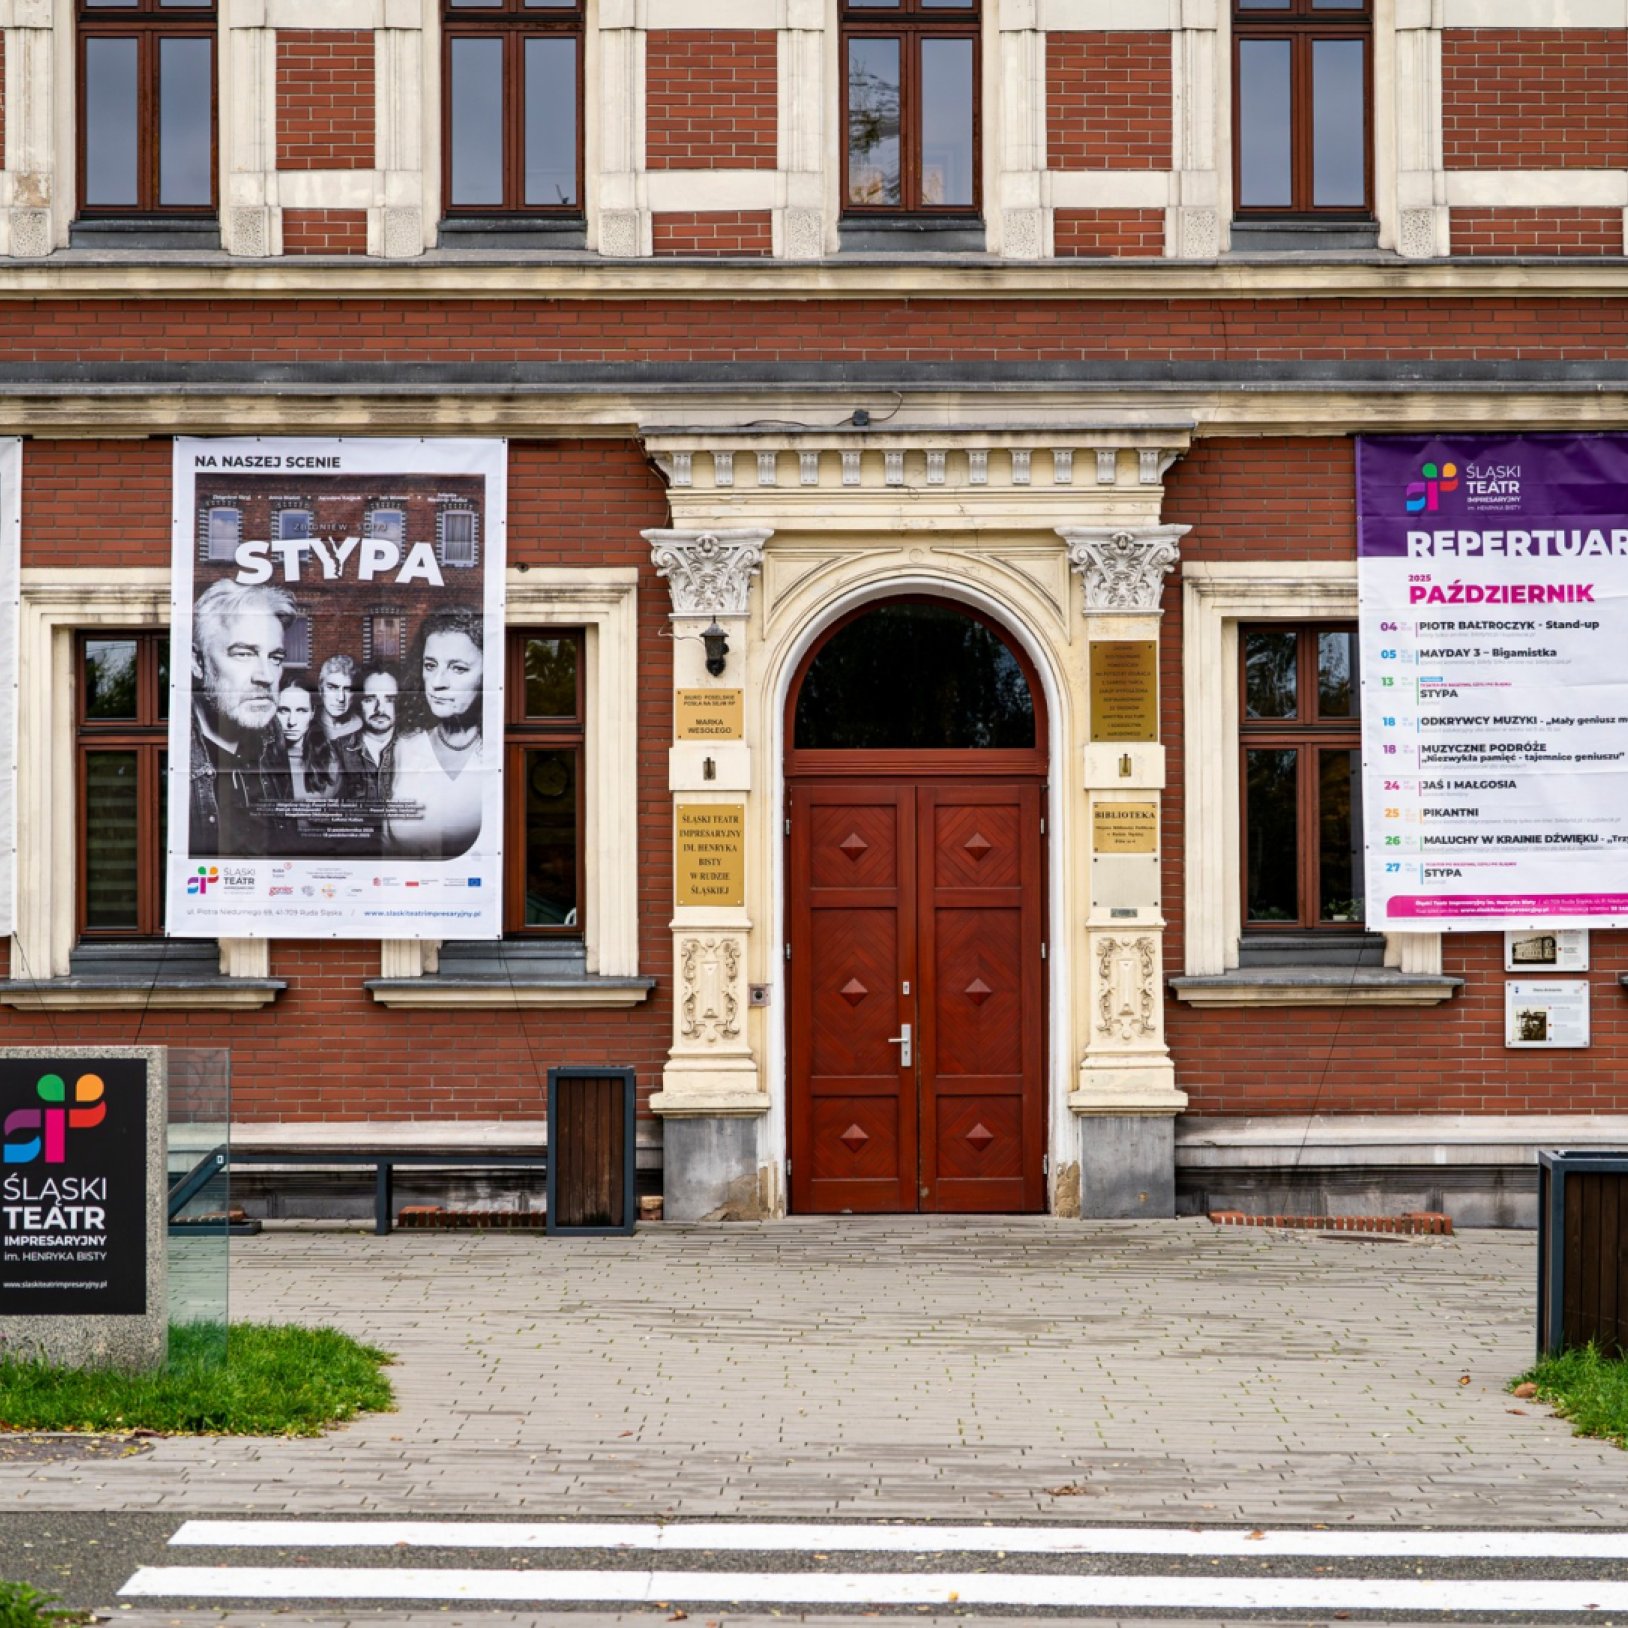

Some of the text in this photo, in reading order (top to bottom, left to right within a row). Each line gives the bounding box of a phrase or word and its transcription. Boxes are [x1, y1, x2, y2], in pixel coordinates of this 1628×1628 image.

[195, 456, 340, 468] NA NASZEJ SCENIE
[1466, 463, 1521, 482] ŚLĄSKI
[1466, 481, 1520, 494] TEATR
[1407, 529, 1628, 558] REPERTUAR
[234, 536, 444, 586] STYPA
[1409, 580, 1596, 604] PAŹDZIERNIK
[1380, 622, 1398, 632] 04
[1420, 622, 1455, 630] PIOTR
[1458, 621, 1535, 630] BAŁTROCZYK
[1546, 620, 1600, 631] Stand-up
[1381, 650, 1396, 659] 05
[1420, 649, 1470, 658] MAYDAY
[1473, 649, 1481, 657] 3
[1492, 648, 1557, 659] Bigamistka
[1381, 677, 1394, 686] 13
[1420, 689, 1458, 698] STYPA
[1382, 718, 1395, 726] 18
[1421, 717, 1489, 725] ODKRYWCY
[1493, 716, 1537, 725] MUZYKI
[1578, 715, 1615, 726] geniusz
[1383, 745, 1396, 754] 18
[1421, 742, 1546, 753] MUZYCZNE PODRÓŻE
[1480, 753, 1516, 764] pamięć
[1525, 753, 1572, 762] tajemnice
[1384, 780, 1400, 790] 24
[1422, 779, 1444, 789] JAŚ
[1454, 780, 1517, 789] MAŁGOSIA
[1384, 808, 1399, 818] 25
[1423, 808, 1479, 817] PIKANTNI
[682, 814, 711, 824] ŚLĄSKI
[1385, 836, 1400, 845] 26
[1424, 836, 1478, 844] MALUCHY
[1497, 835, 1542, 843] KRAINIE
[1544, 832, 1598, 845] DŹWIĘKU
[1385, 862, 1400, 872] 27
[700, 872, 730, 880] RUDZIE
[1424, 869, 1462, 877] STYPA
[224, 877, 255, 885] TEATR
[691, 884, 729, 896] ŚLĄSKIEJ
[3, 1172, 107, 1206] ŚLĄSKI
[3, 1206, 105, 1230] TEATR
[4, 1235, 107, 1246] IMPRESARYJNY
[4, 1252, 107, 1261] im. HENRYKA BISTY
[3, 1280, 107, 1289] www.slaskiteatrimpresaryjny.pl
